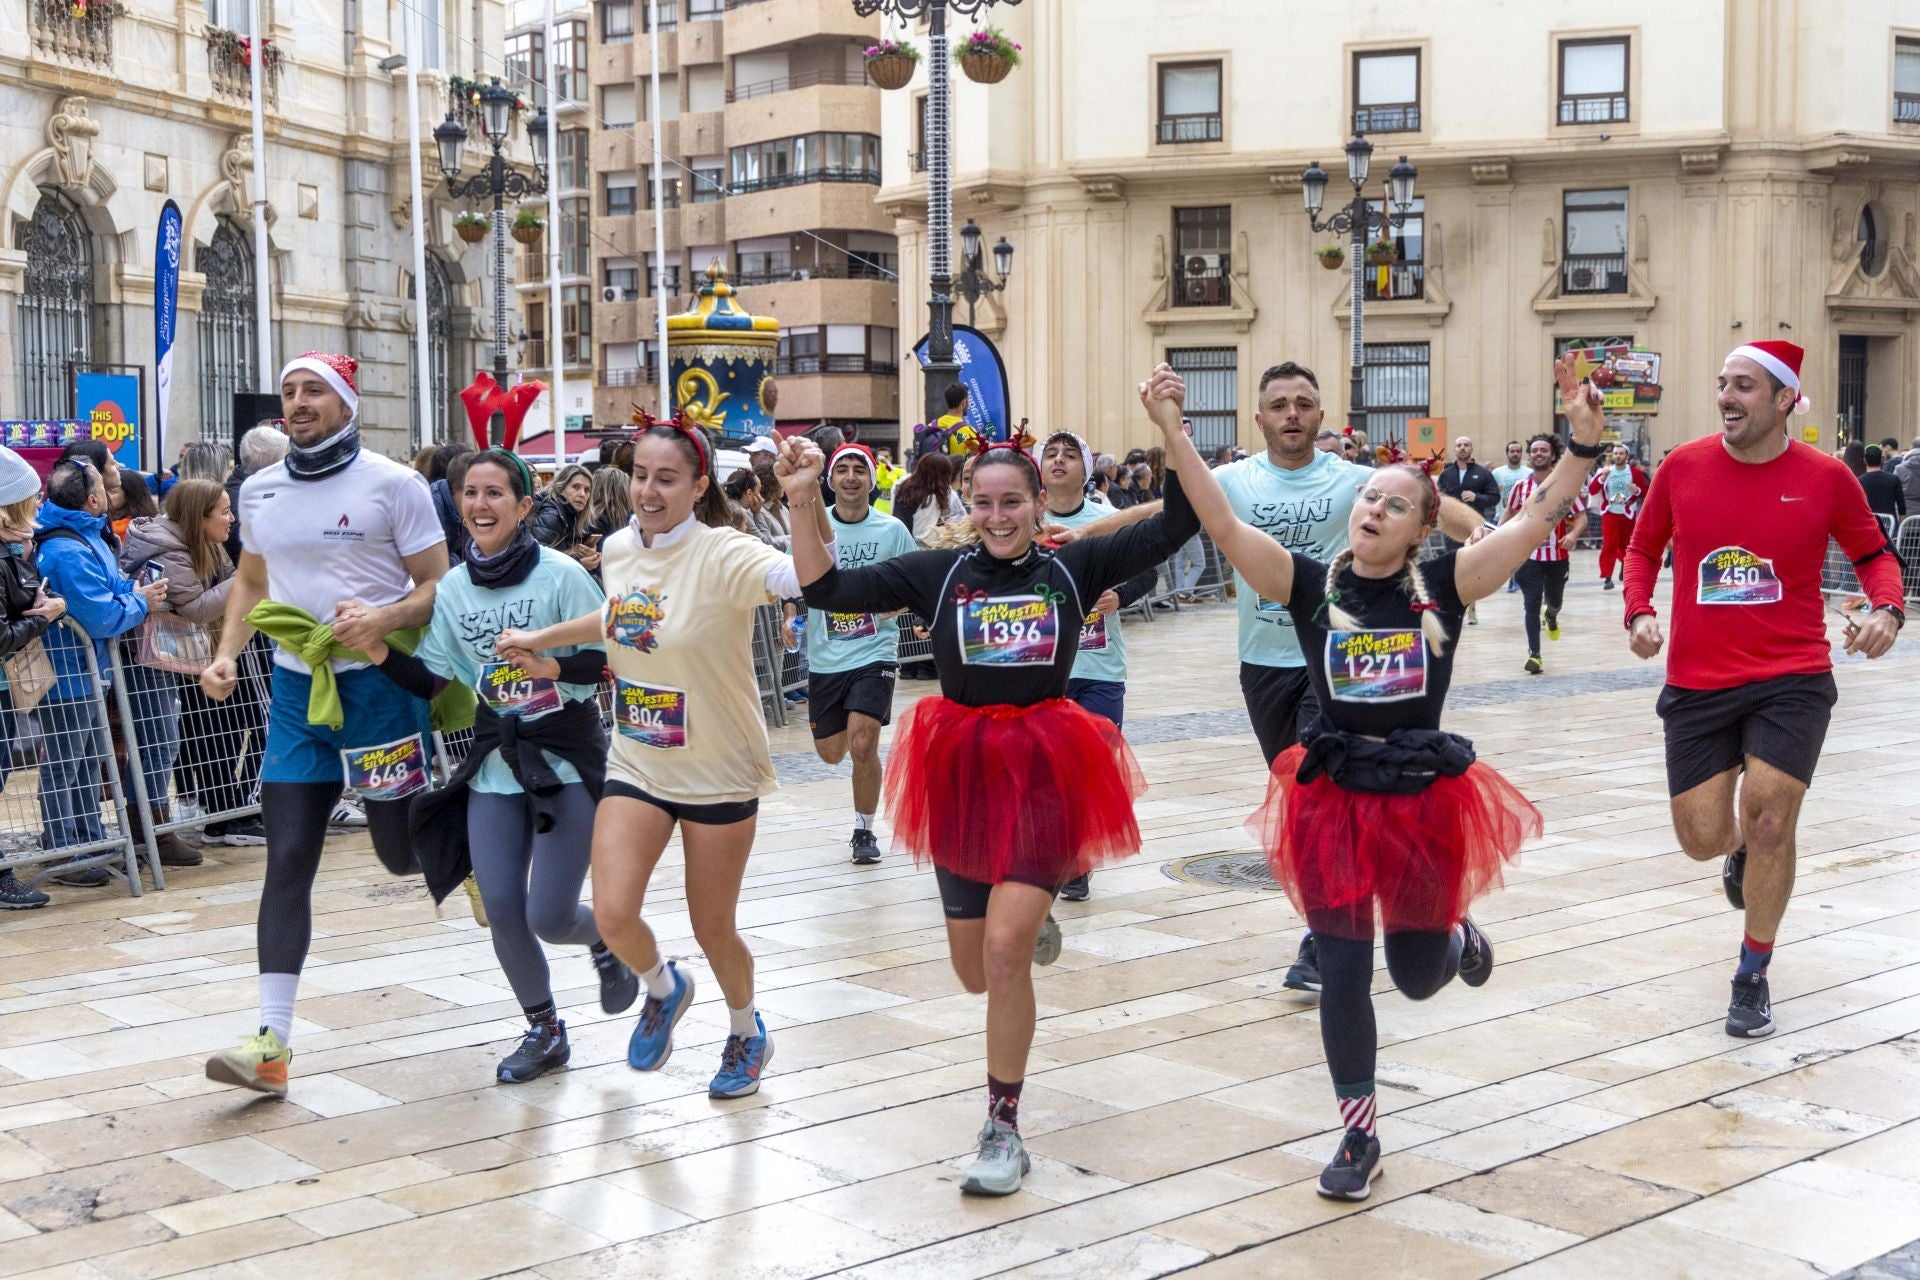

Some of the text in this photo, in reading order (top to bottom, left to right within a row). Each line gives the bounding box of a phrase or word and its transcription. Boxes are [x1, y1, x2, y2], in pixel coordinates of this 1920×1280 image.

[1605, 396, 1631, 406] NCE
[89, 410, 112, 421] THIS
[91, 422, 135, 441] POP!
[1250, 498, 1332, 528] SAN
[839, 542, 879, 562] AN
[1717, 551, 1739, 562] SAN
[1720, 567, 1760, 586] 450
[606, 601, 656, 628] JUEGA
[981, 602, 1046, 623] SILVESTRE
[982, 603, 1008, 615] SAN
[459, 598, 534, 642] SAN
[832, 618, 866, 632] 2582
[979, 621, 1041, 645] 1396
[1348, 633, 1373, 645] SAN
[1347, 632, 1414, 656] SILVESTRE
[495, 665, 509, 678] SAN
[1344, 653, 1406, 679] 1271
[497, 680, 533, 703] 647
[625, 693, 678, 705] SILVESTRE
[627, 687, 645, 697] SAN
[629, 704, 664, 730] 804
[362, 749, 385, 762] SAN
[363, 740, 415, 771] SILVESTRE
[369, 761, 409, 788] 648
